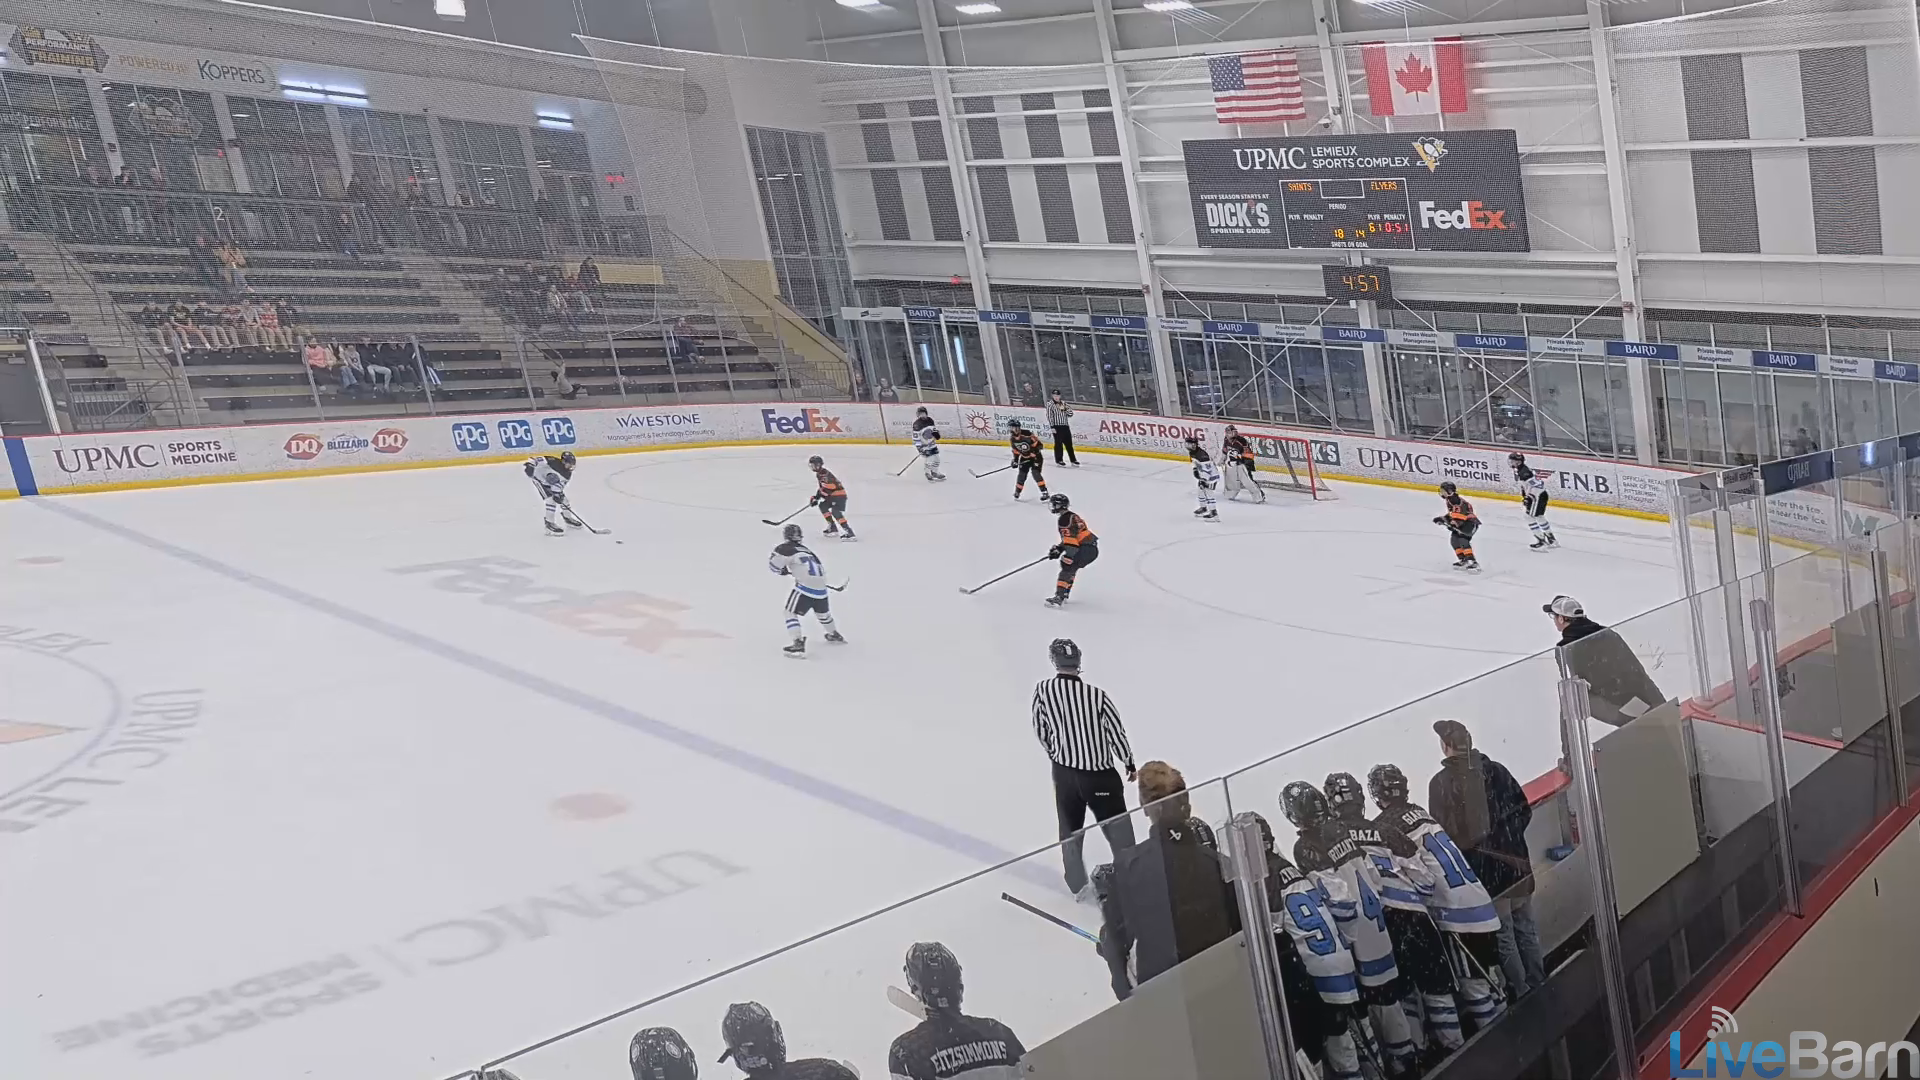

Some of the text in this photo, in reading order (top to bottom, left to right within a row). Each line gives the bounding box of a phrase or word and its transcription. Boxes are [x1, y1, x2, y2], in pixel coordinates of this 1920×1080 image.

[196, 58, 265, 84] KOPPERS
[1232, 146, 1358, 170] UPMC LEMIEUX
[1312, 157, 1410, 169] SPORTS COMPLEX
[1288, 183, 1312, 191] SAINTS
[1371, 182, 1397, 190] FLYERS
[1205, 202, 1270, 227] DICK'S
[1418, 201, 1507, 230] FedEx
[1334, 229, 1345, 239] 18
[1355, 230, 1366, 239] 14
[1343, 275, 1381, 293] 4:57
[908, 309, 936, 319] BAIRD
[990, 312, 1017, 322] BAIRD
[1105, 317, 1130, 327] BAIRD
[1217, 323, 1243, 332] BAIRD
[1338, 329, 1367, 339] BAIRD
[1475, 336, 1507, 347] BAIRD
[1547, 345, 1583, 353] Management
[1625, 344, 1657, 356] BAIRD
[1769, 354, 1797, 366] BAIRD
[1885, 364, 1907, 378] BAIRD
[616, 413, 701, 428] WAVESTONE
[761, 408, 842, 433] FedEx
[994, 413, 1036, 422] Bradenton
[453, 425, 487, 449] PPG
[499, 422, 532, 446] PPG
[543, 419, 574, 443] PPG
[607, 433, 646, 442] Management
[685, 429, 715, 437] Consulting
[1099, 419, 1206, 441] ARMSTRONG
[290, 438, 320, 454] DQ
[327, 438, 369, 450] BLIZZARD
[377, 432, 403, 448] DQ
[1099, 434, 1147, 446] BUSINESS
[53, 440, 222, 473] UPMC SPORTS
[171, 452, 238, 466] MEDICINE
[1356, 447, 1489, 475] UPMC SPORTS
[1444, 468, 1501, 482] MEDICINE
[1559, 471, 1613, 494] F.N.B.
[1777, 500, 1788, 508] for
[1789, 502, 1804, 510] the
[1793, 512, 1809, 521] the
[1348, 829, 1382, 842] BAZA
[399, 848, 749, 967] UPMC
[49, 951, 360, 1054] MEDICINE
[134, 970, 385, 1059] SPORTS
